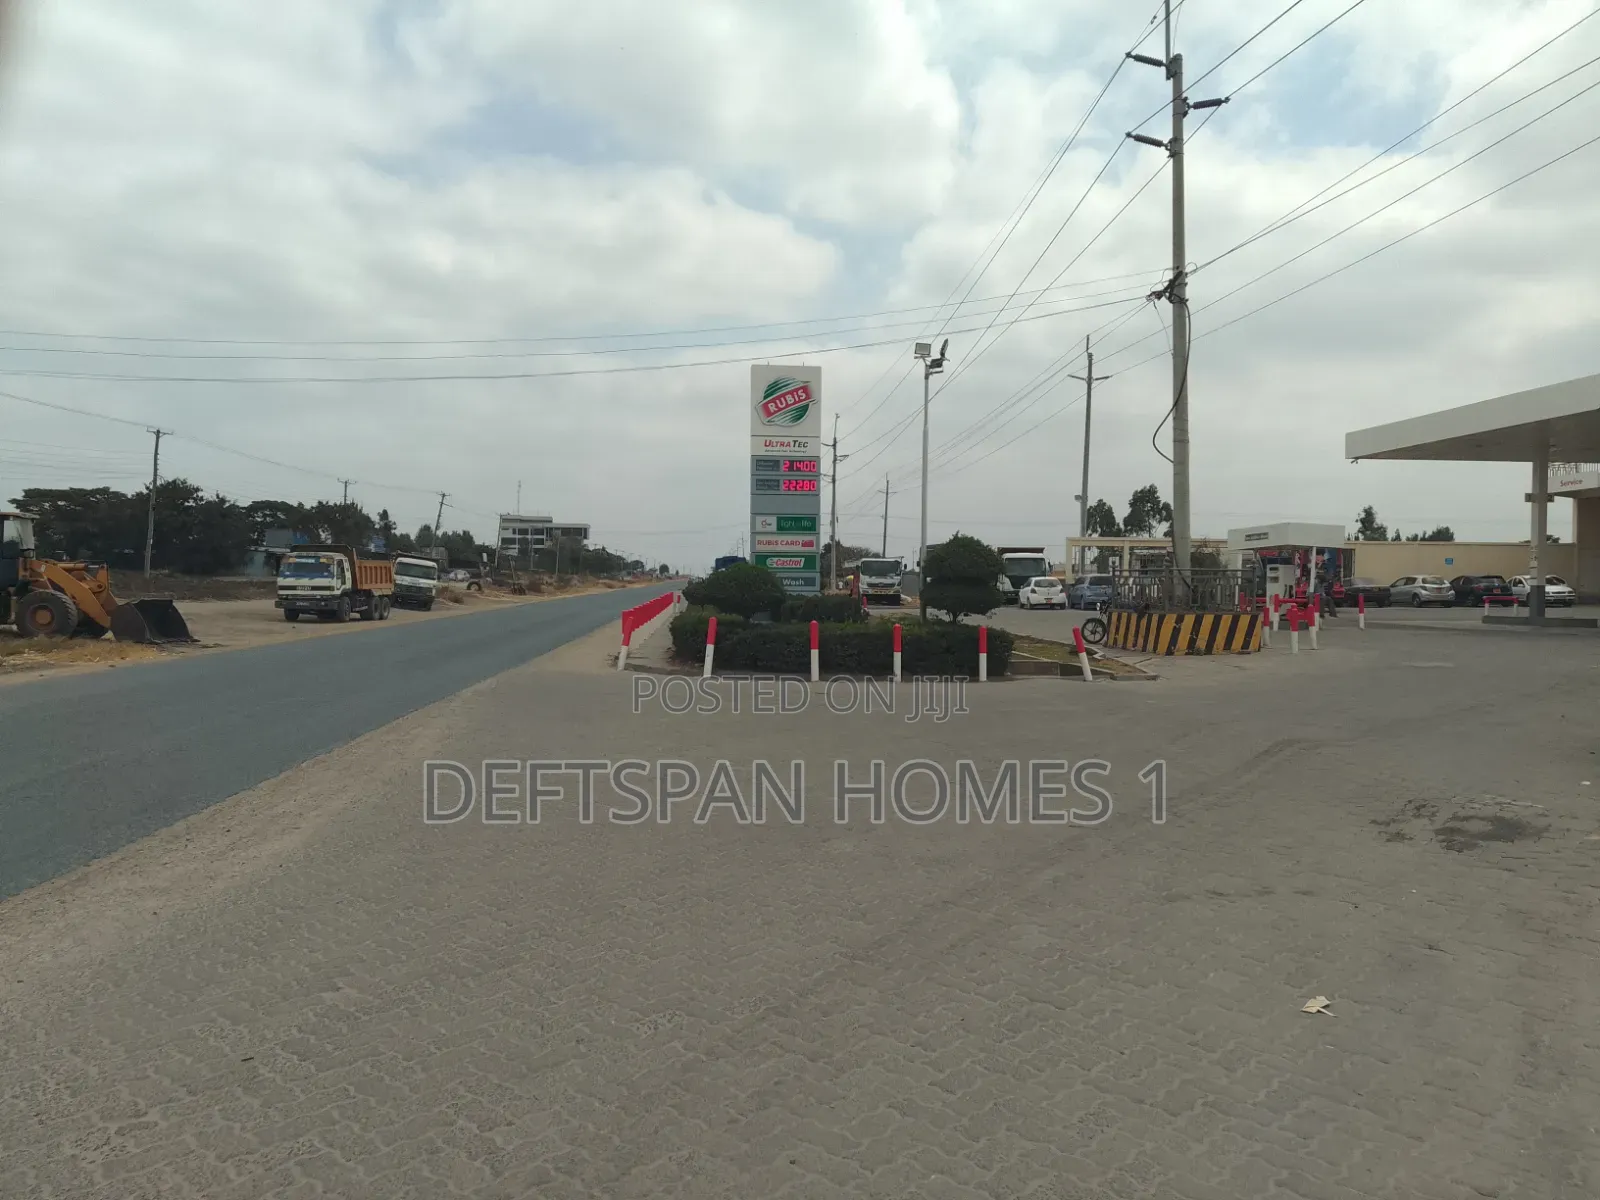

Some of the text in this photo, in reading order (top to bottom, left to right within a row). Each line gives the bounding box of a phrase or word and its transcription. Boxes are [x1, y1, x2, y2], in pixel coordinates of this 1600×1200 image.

[1560, 479, 1584, 487] Service
[775, 558, 802, 567] Castrol
[782, 578, 804, 586] Wash
